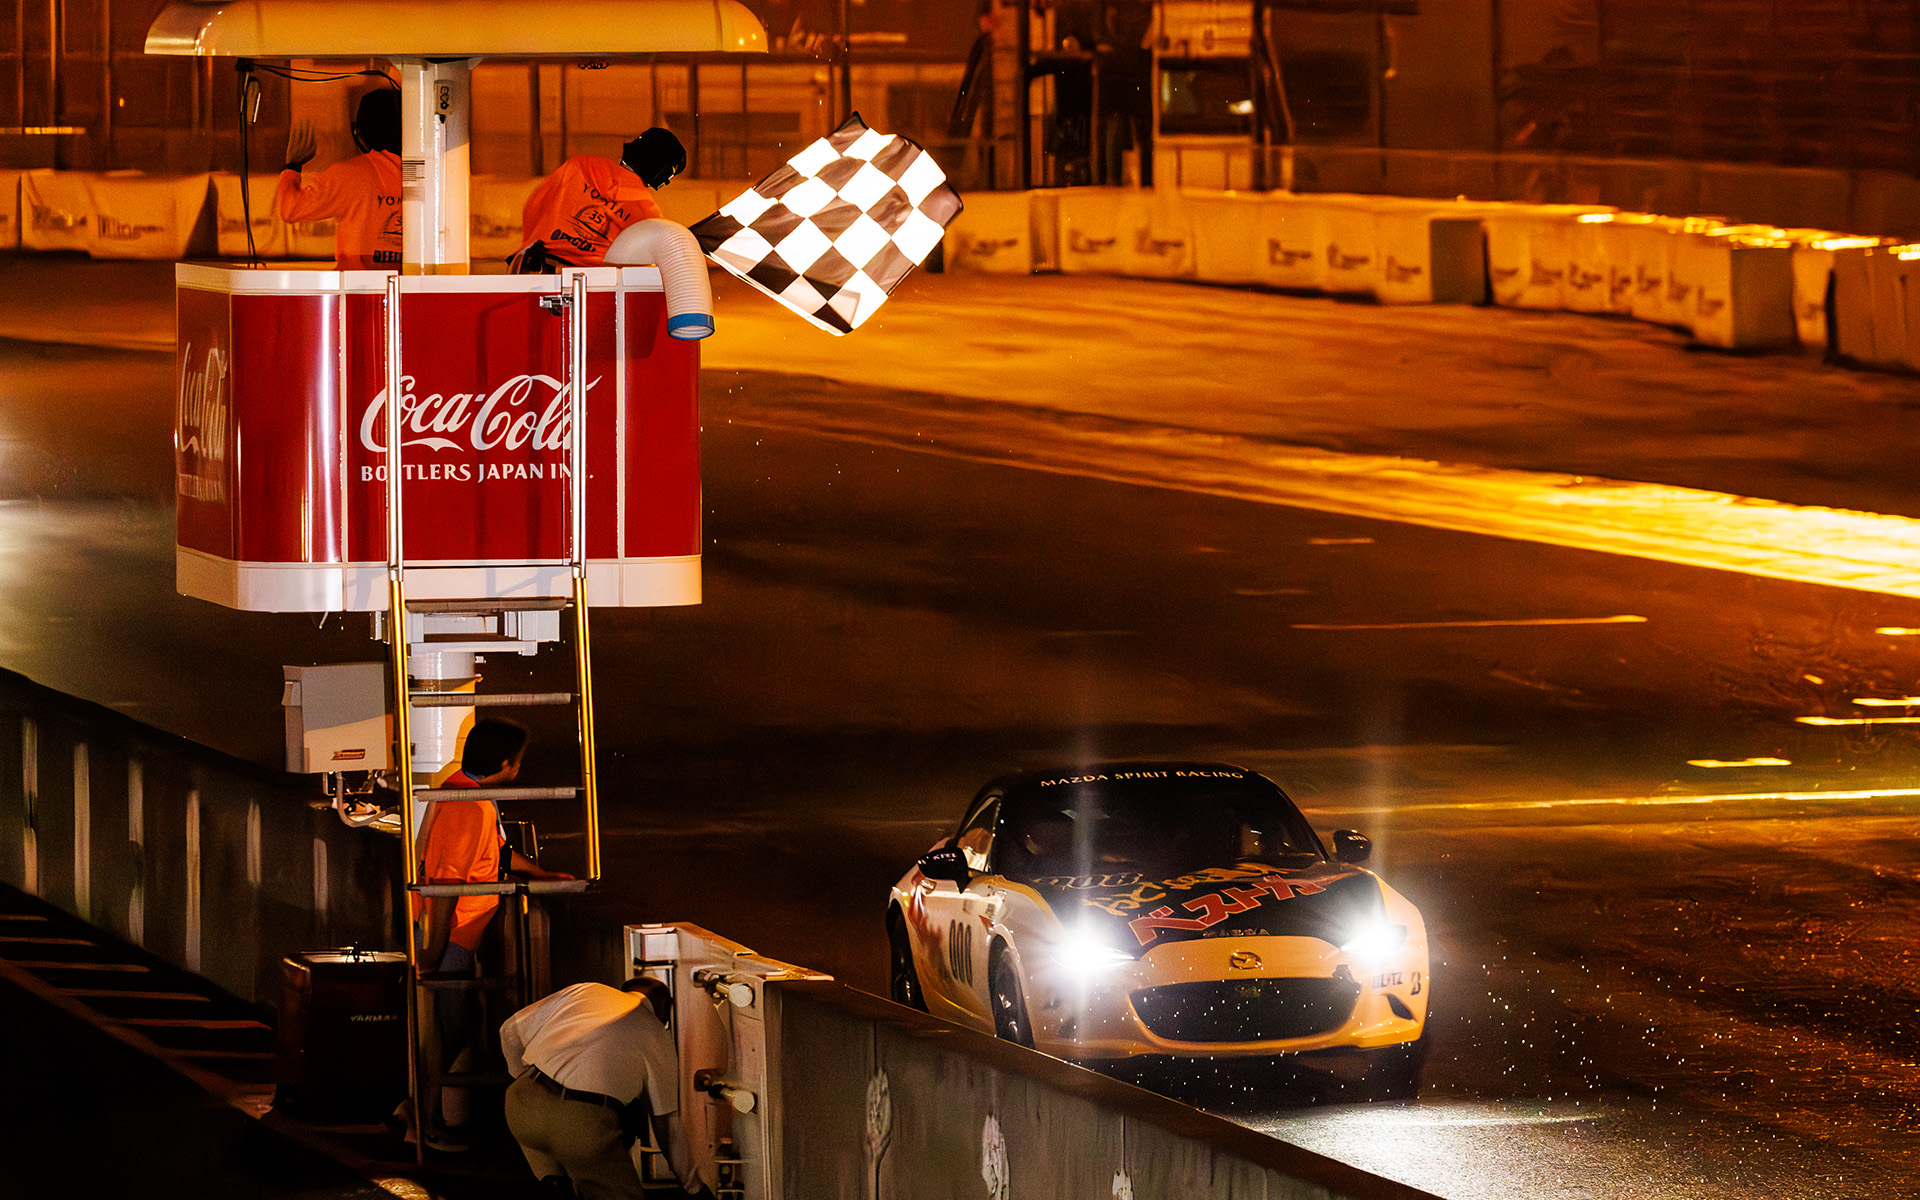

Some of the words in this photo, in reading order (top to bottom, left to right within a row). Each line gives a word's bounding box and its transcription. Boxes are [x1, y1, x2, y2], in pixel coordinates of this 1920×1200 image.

[588, 210, 605, 224] 35
[360, 374, 603, 452] Coca-Cola
[361, 464, 471, 482] BOTLERS
[478, 464, 543, 483] JAPAN
[551, 464, 594, 480] IN.
[1041, 774, 1109, 787] MAZDA
[1114, 771, 1168, 780] SPIRIT
[1176, 770, 1244, 780] RACING
